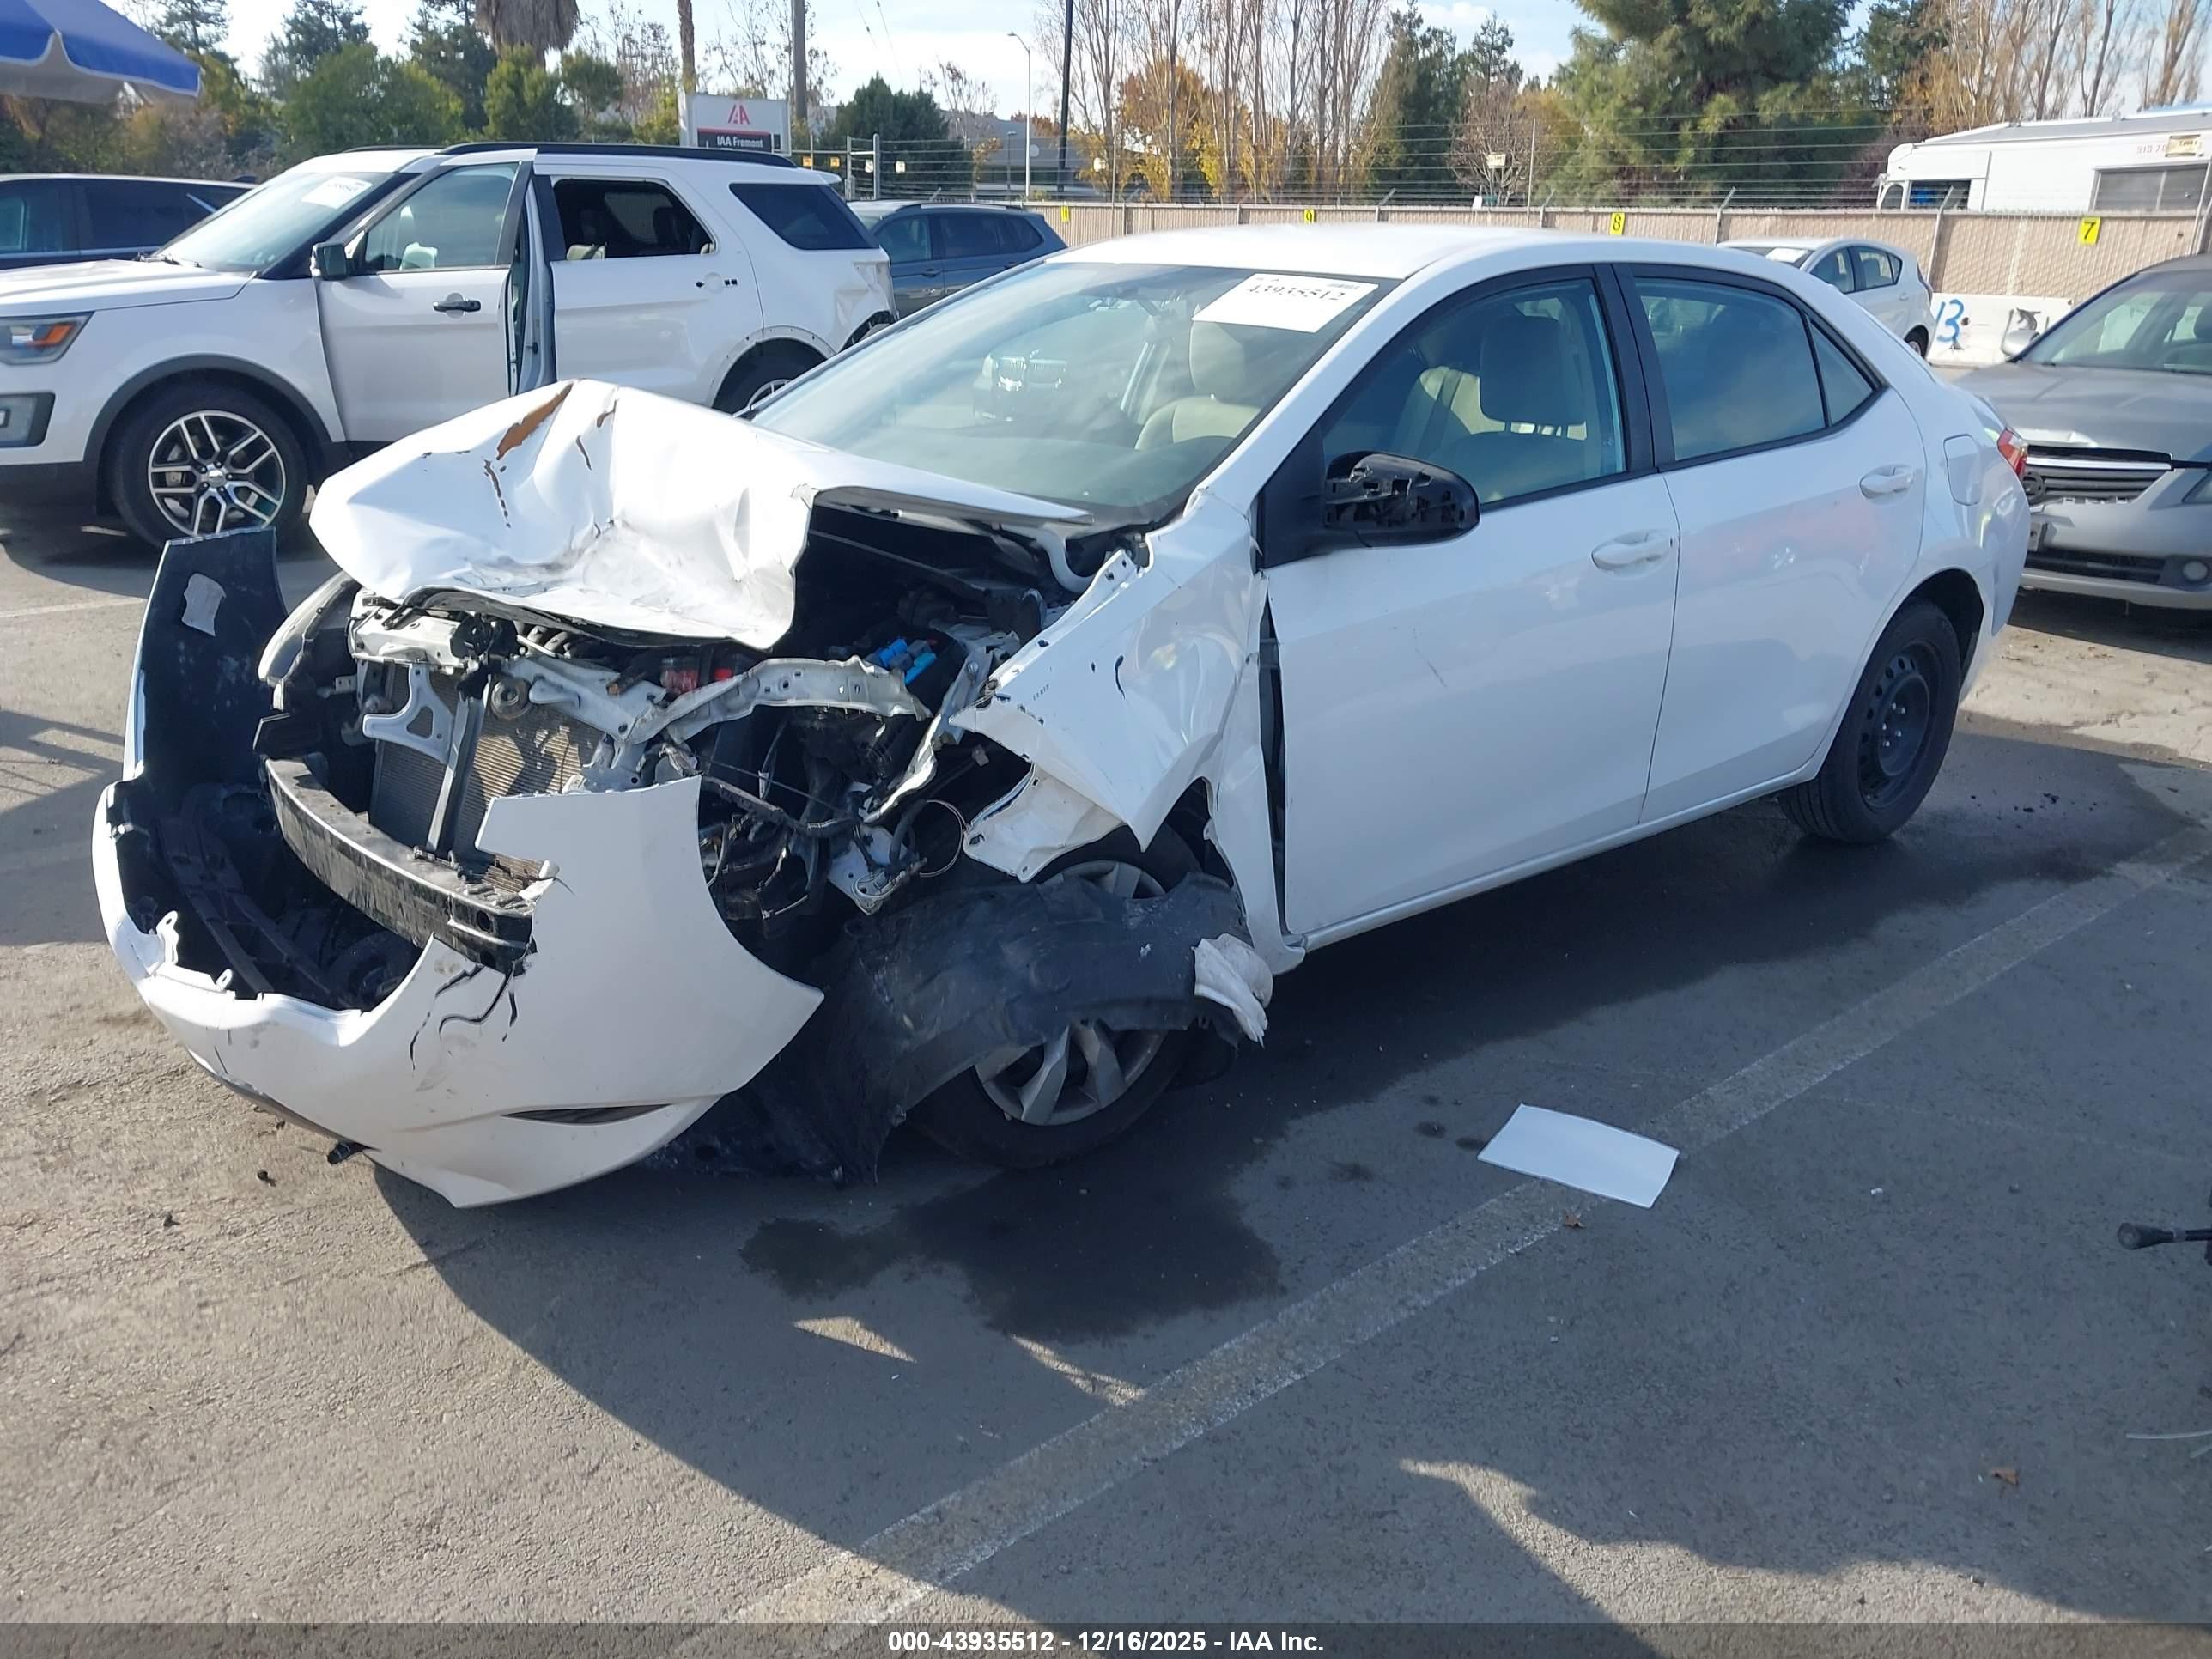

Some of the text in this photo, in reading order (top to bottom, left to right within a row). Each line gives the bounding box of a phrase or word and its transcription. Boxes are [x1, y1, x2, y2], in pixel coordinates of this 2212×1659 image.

[717, 136, 763, 148] IAA Fremont
[1305, 210, 1313, 222] 9
[1613, 214, 1622, 231] 8
[2083, 220, 2097, 240] 7
